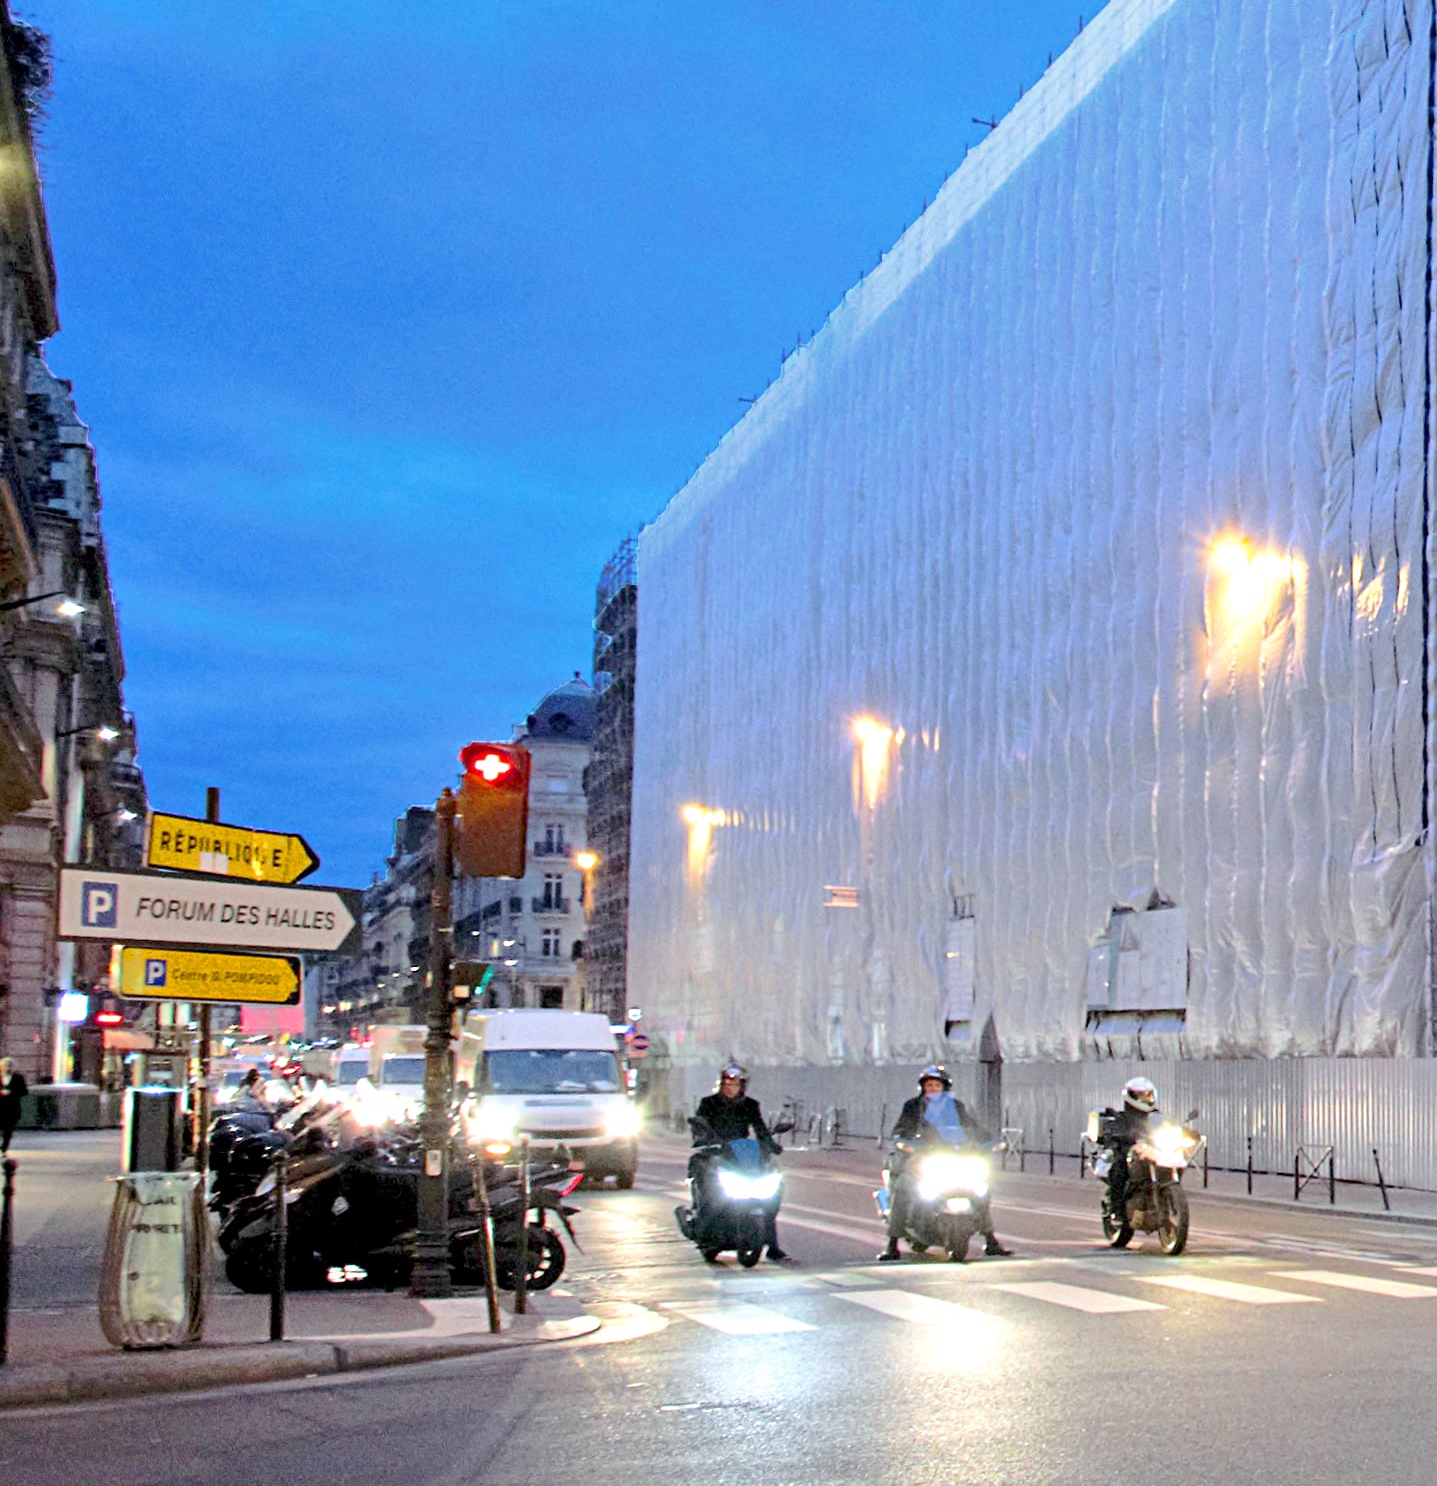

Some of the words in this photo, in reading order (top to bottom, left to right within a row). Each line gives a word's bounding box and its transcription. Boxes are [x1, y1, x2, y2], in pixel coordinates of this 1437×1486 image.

[136, 897, 214, 921] FORUM
[220, 904, 259, 925] DES
[265, 906, 336, 930] HALLES
[172, 968, 208, 983] Centre
[224, 971, 279, 985] POMPIDOU
